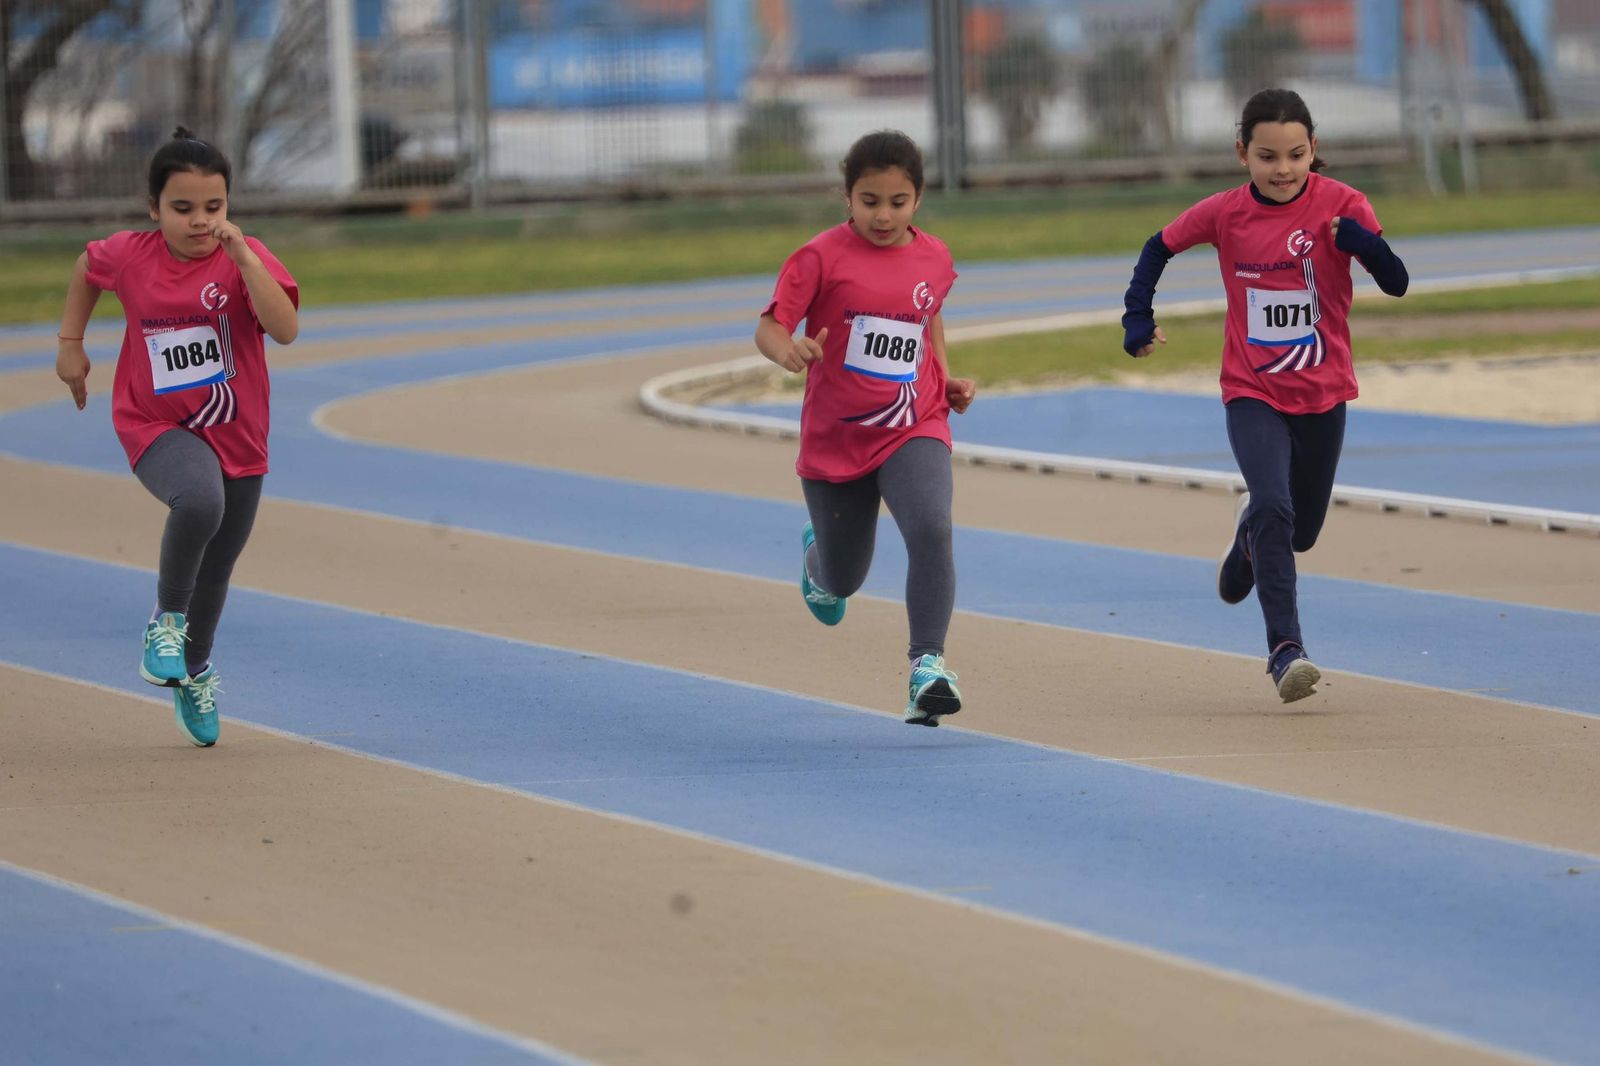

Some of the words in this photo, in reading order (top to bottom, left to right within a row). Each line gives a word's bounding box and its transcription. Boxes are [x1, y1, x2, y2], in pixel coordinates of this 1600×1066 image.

[1263, 303, 1312, 328] 1071
[161, 339, 220, 372] 1084
[863, 332, 917, 363] 1088
